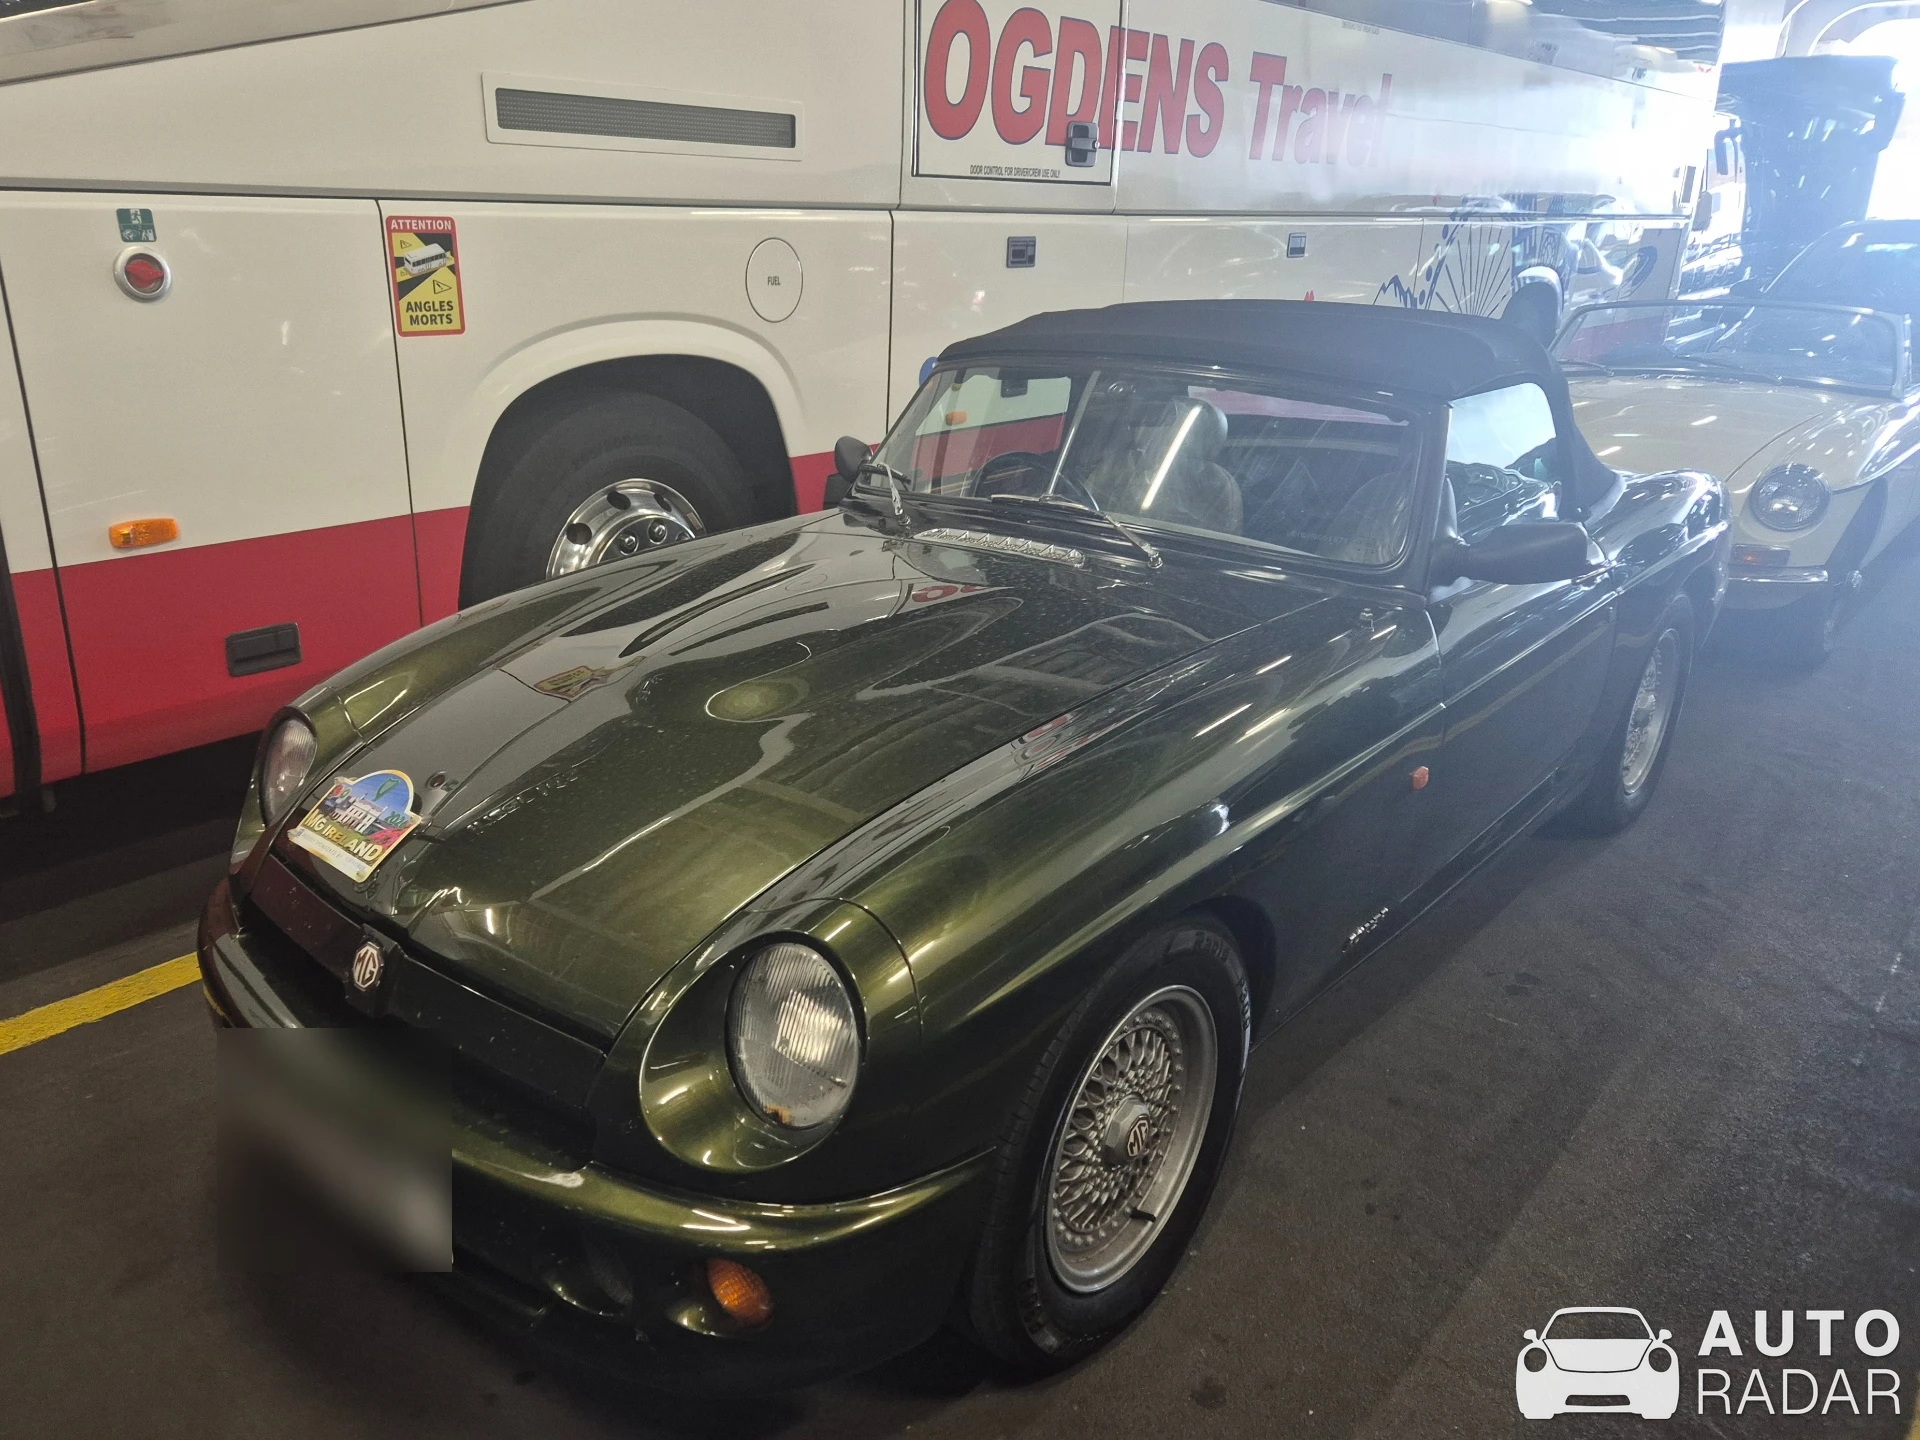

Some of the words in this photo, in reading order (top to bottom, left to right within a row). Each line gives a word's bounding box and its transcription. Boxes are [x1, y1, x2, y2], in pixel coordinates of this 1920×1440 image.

[924, 0, 1229, 158] OGDENS
[1249, 51, 1393, 168] Travel
[970, 164, 983, 175] DOOR
[984, 165, 1003, 176] CONTROL
[1005, 166, 1013, 176] FOR
[391, 219, 452, 230] ATTENTION
[767, 276, 781, 286] FUEL
[406, 301, 454, 313] ANGLES
[409, 314, 453, 326] MORTS
[304, 808, 326, 832] MG
[322, 825, 383, 861] IRELAND
[353, 945, 379, 988] MG
